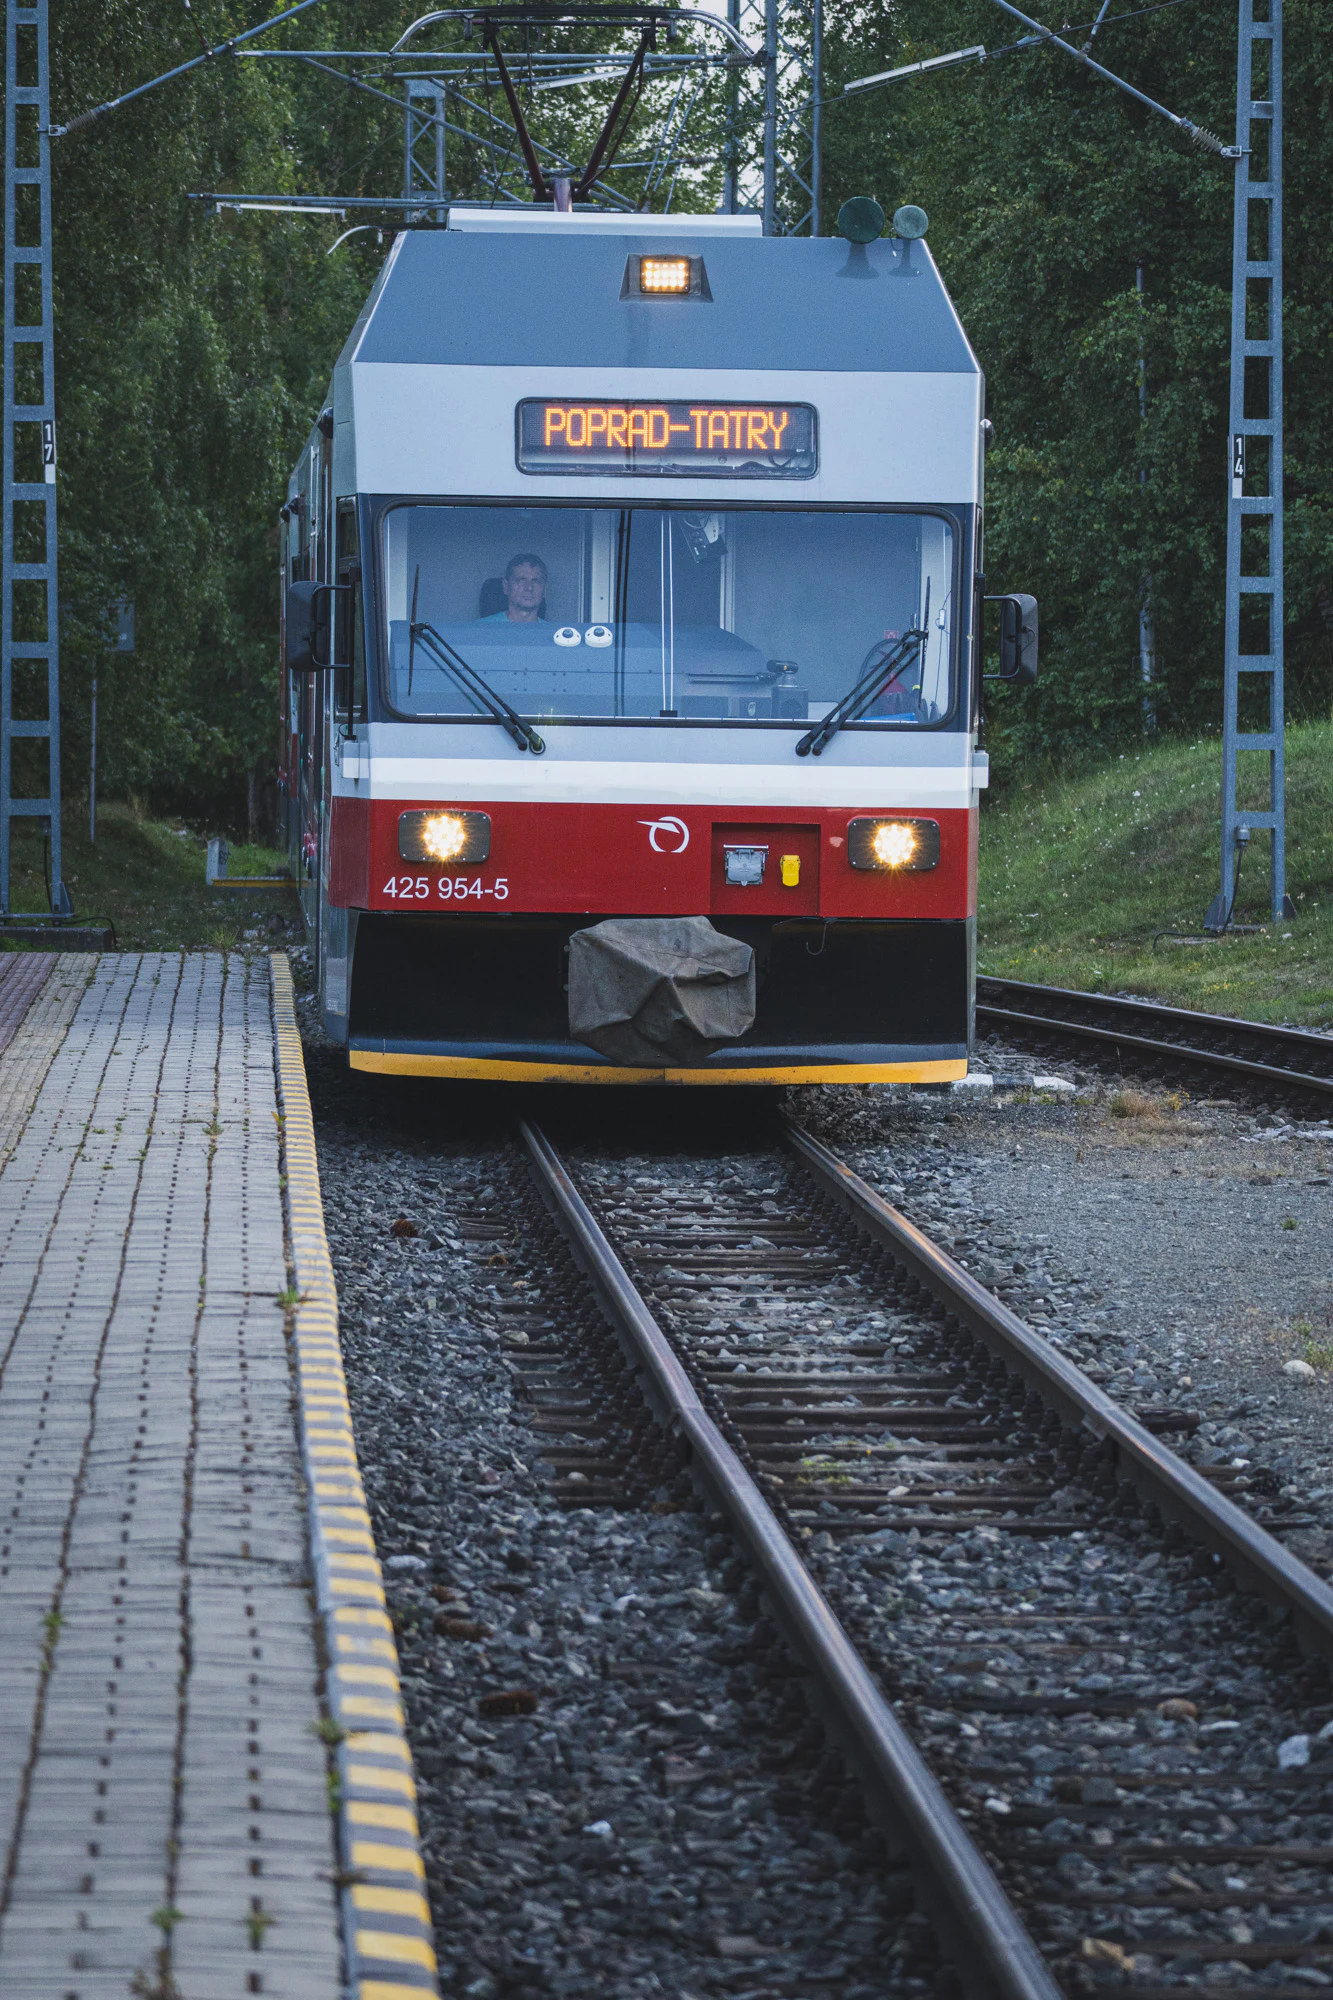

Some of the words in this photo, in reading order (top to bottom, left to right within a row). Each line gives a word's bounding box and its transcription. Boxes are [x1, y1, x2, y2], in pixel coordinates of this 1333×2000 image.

[45, 424, 53, 461] 17
[544, 408, 788, 449] POPRAD-TATRY
[1234, 437, 1244, 475] 14
[382, 876, 430, 899] 425
[438, 877, 509, 900] 954-5
